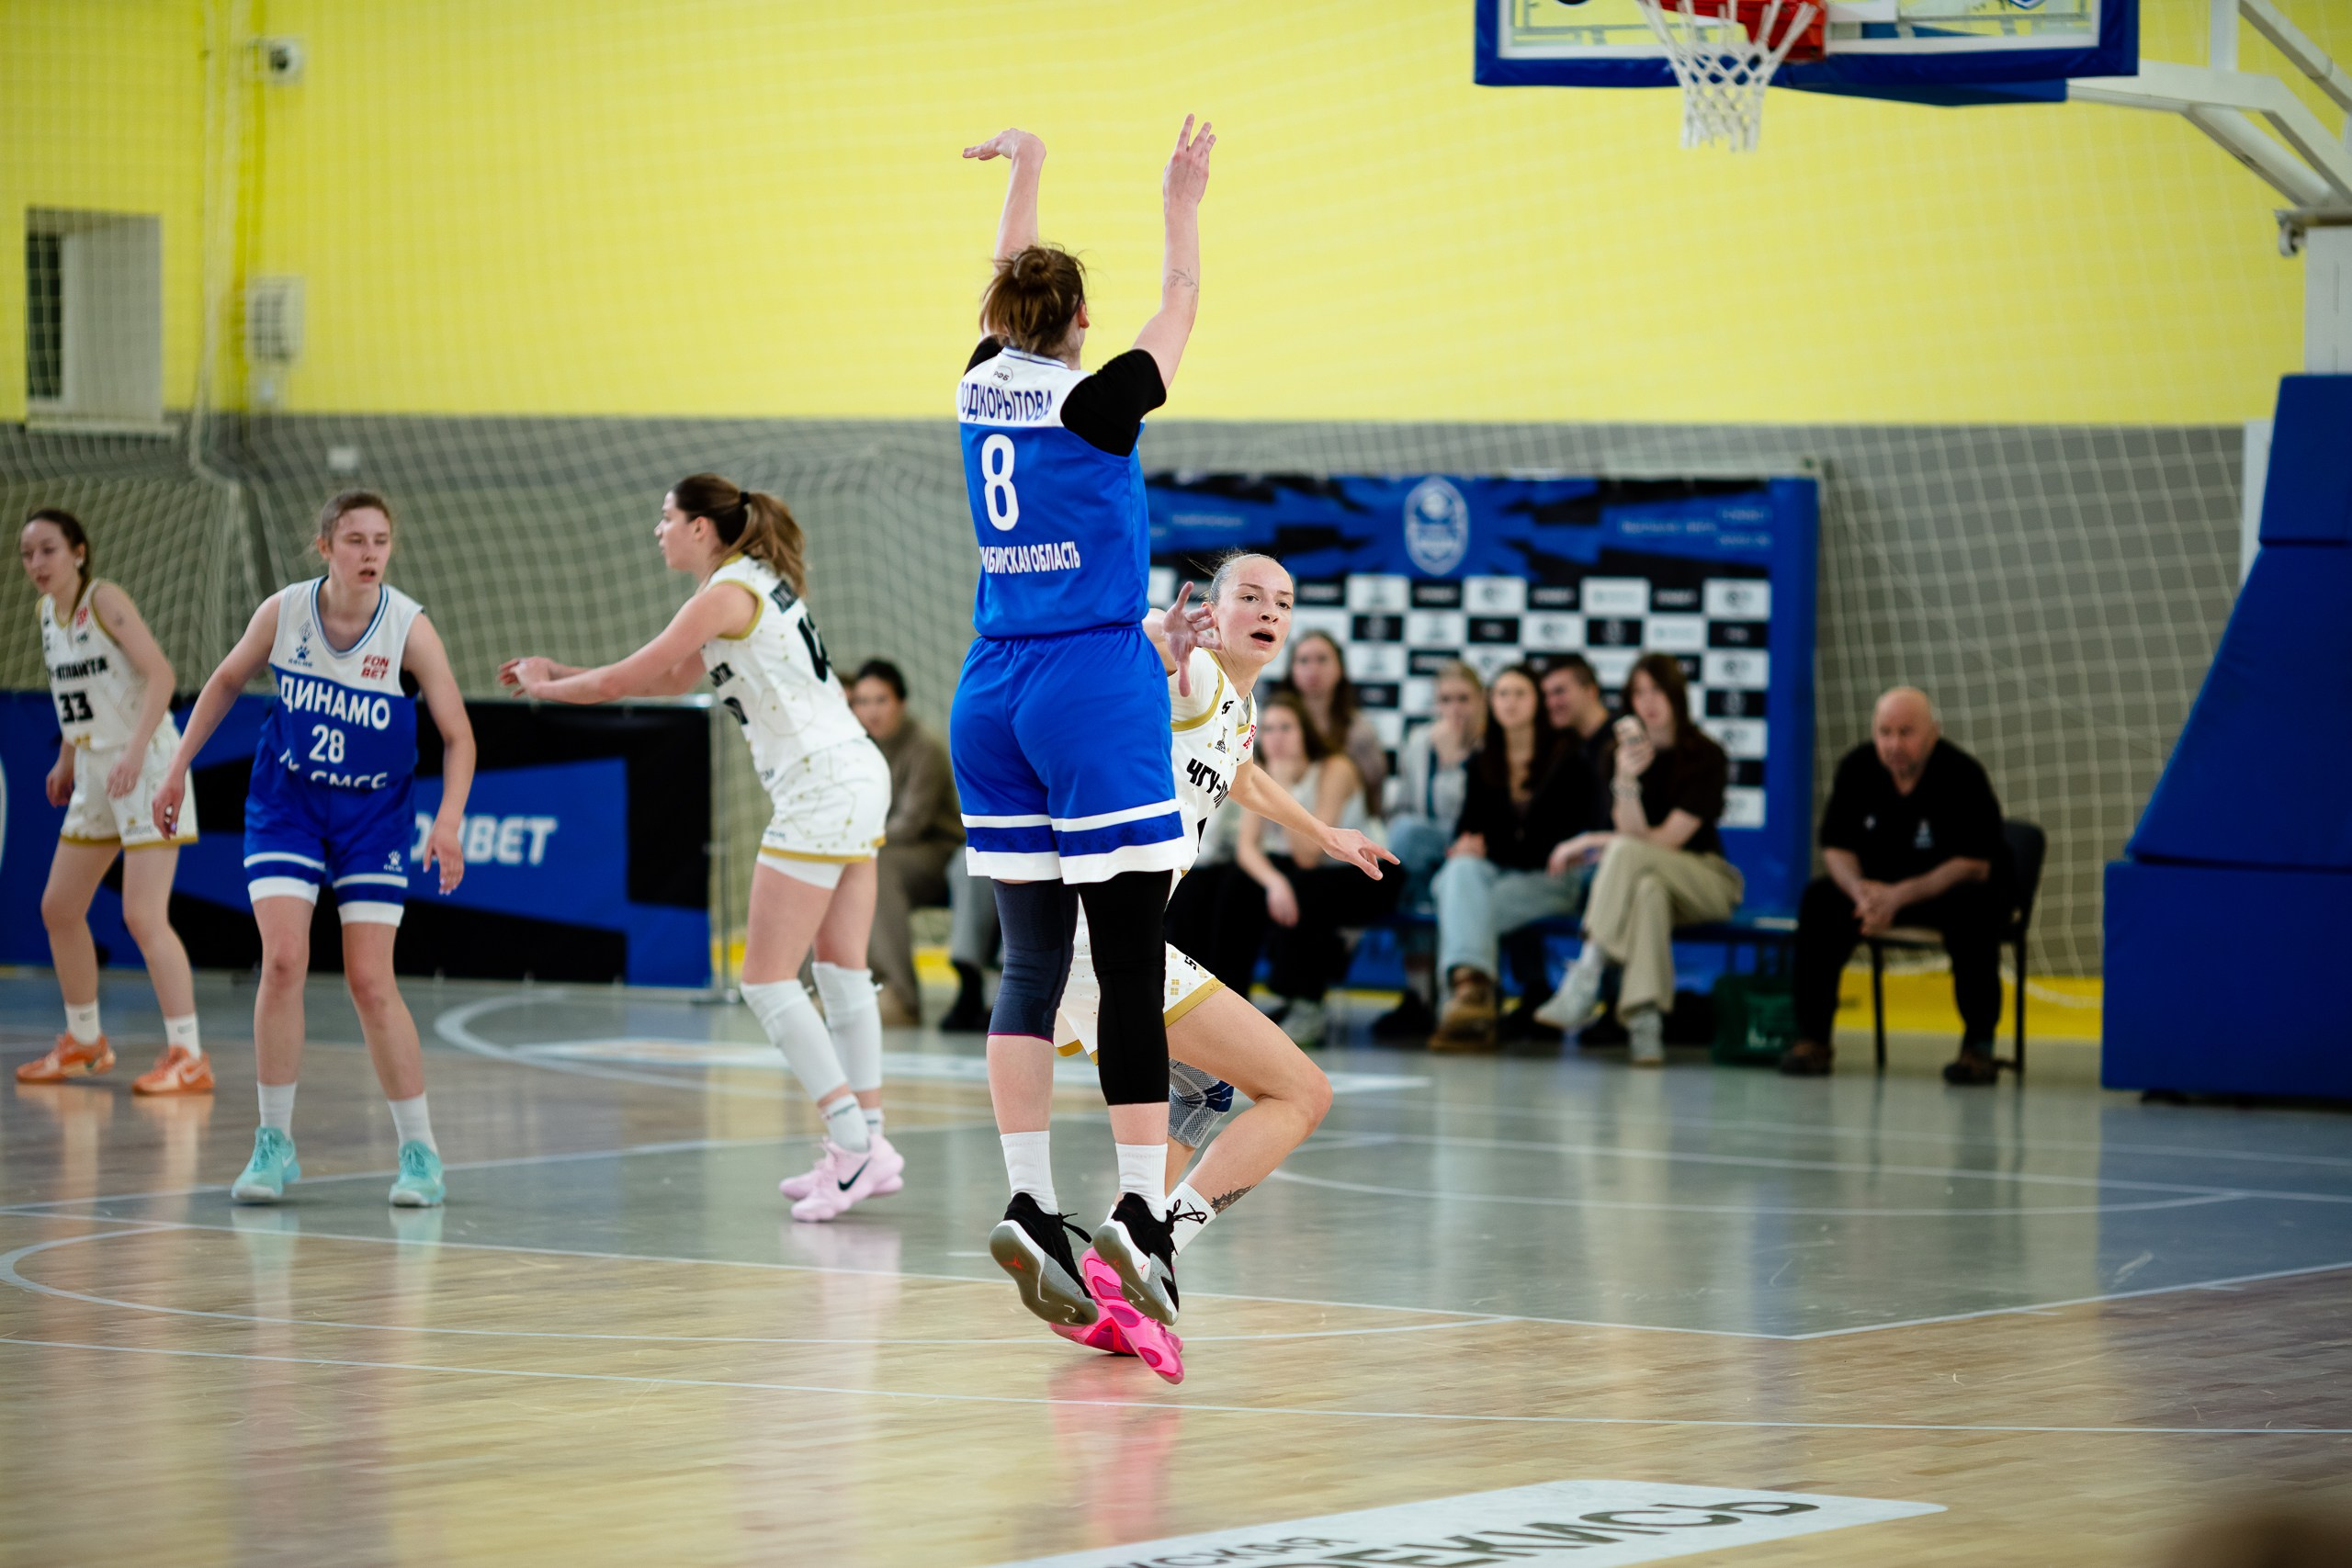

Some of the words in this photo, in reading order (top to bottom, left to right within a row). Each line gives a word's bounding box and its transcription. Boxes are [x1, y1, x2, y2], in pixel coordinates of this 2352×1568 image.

[961, 381, 1052, 422] ОДКОРЫТОВА
[981, 434, 1020, 531] 8
[979, 546, 1032, 574] ИБИРСКАЯ
[1030, 541, 1081, 572] ОБЛАСТЬ
[49, 656, 107, 682] -АТЛАНТА
[361, 668, 387, 680] BET
[363, 654, 390, 668] FON
[59, 691, 93, 723] 33
[280, 674, 390, 731] ДИНАМО
[309, 724, 345, 763] 28
[411, 813, 559, 865] OBET
